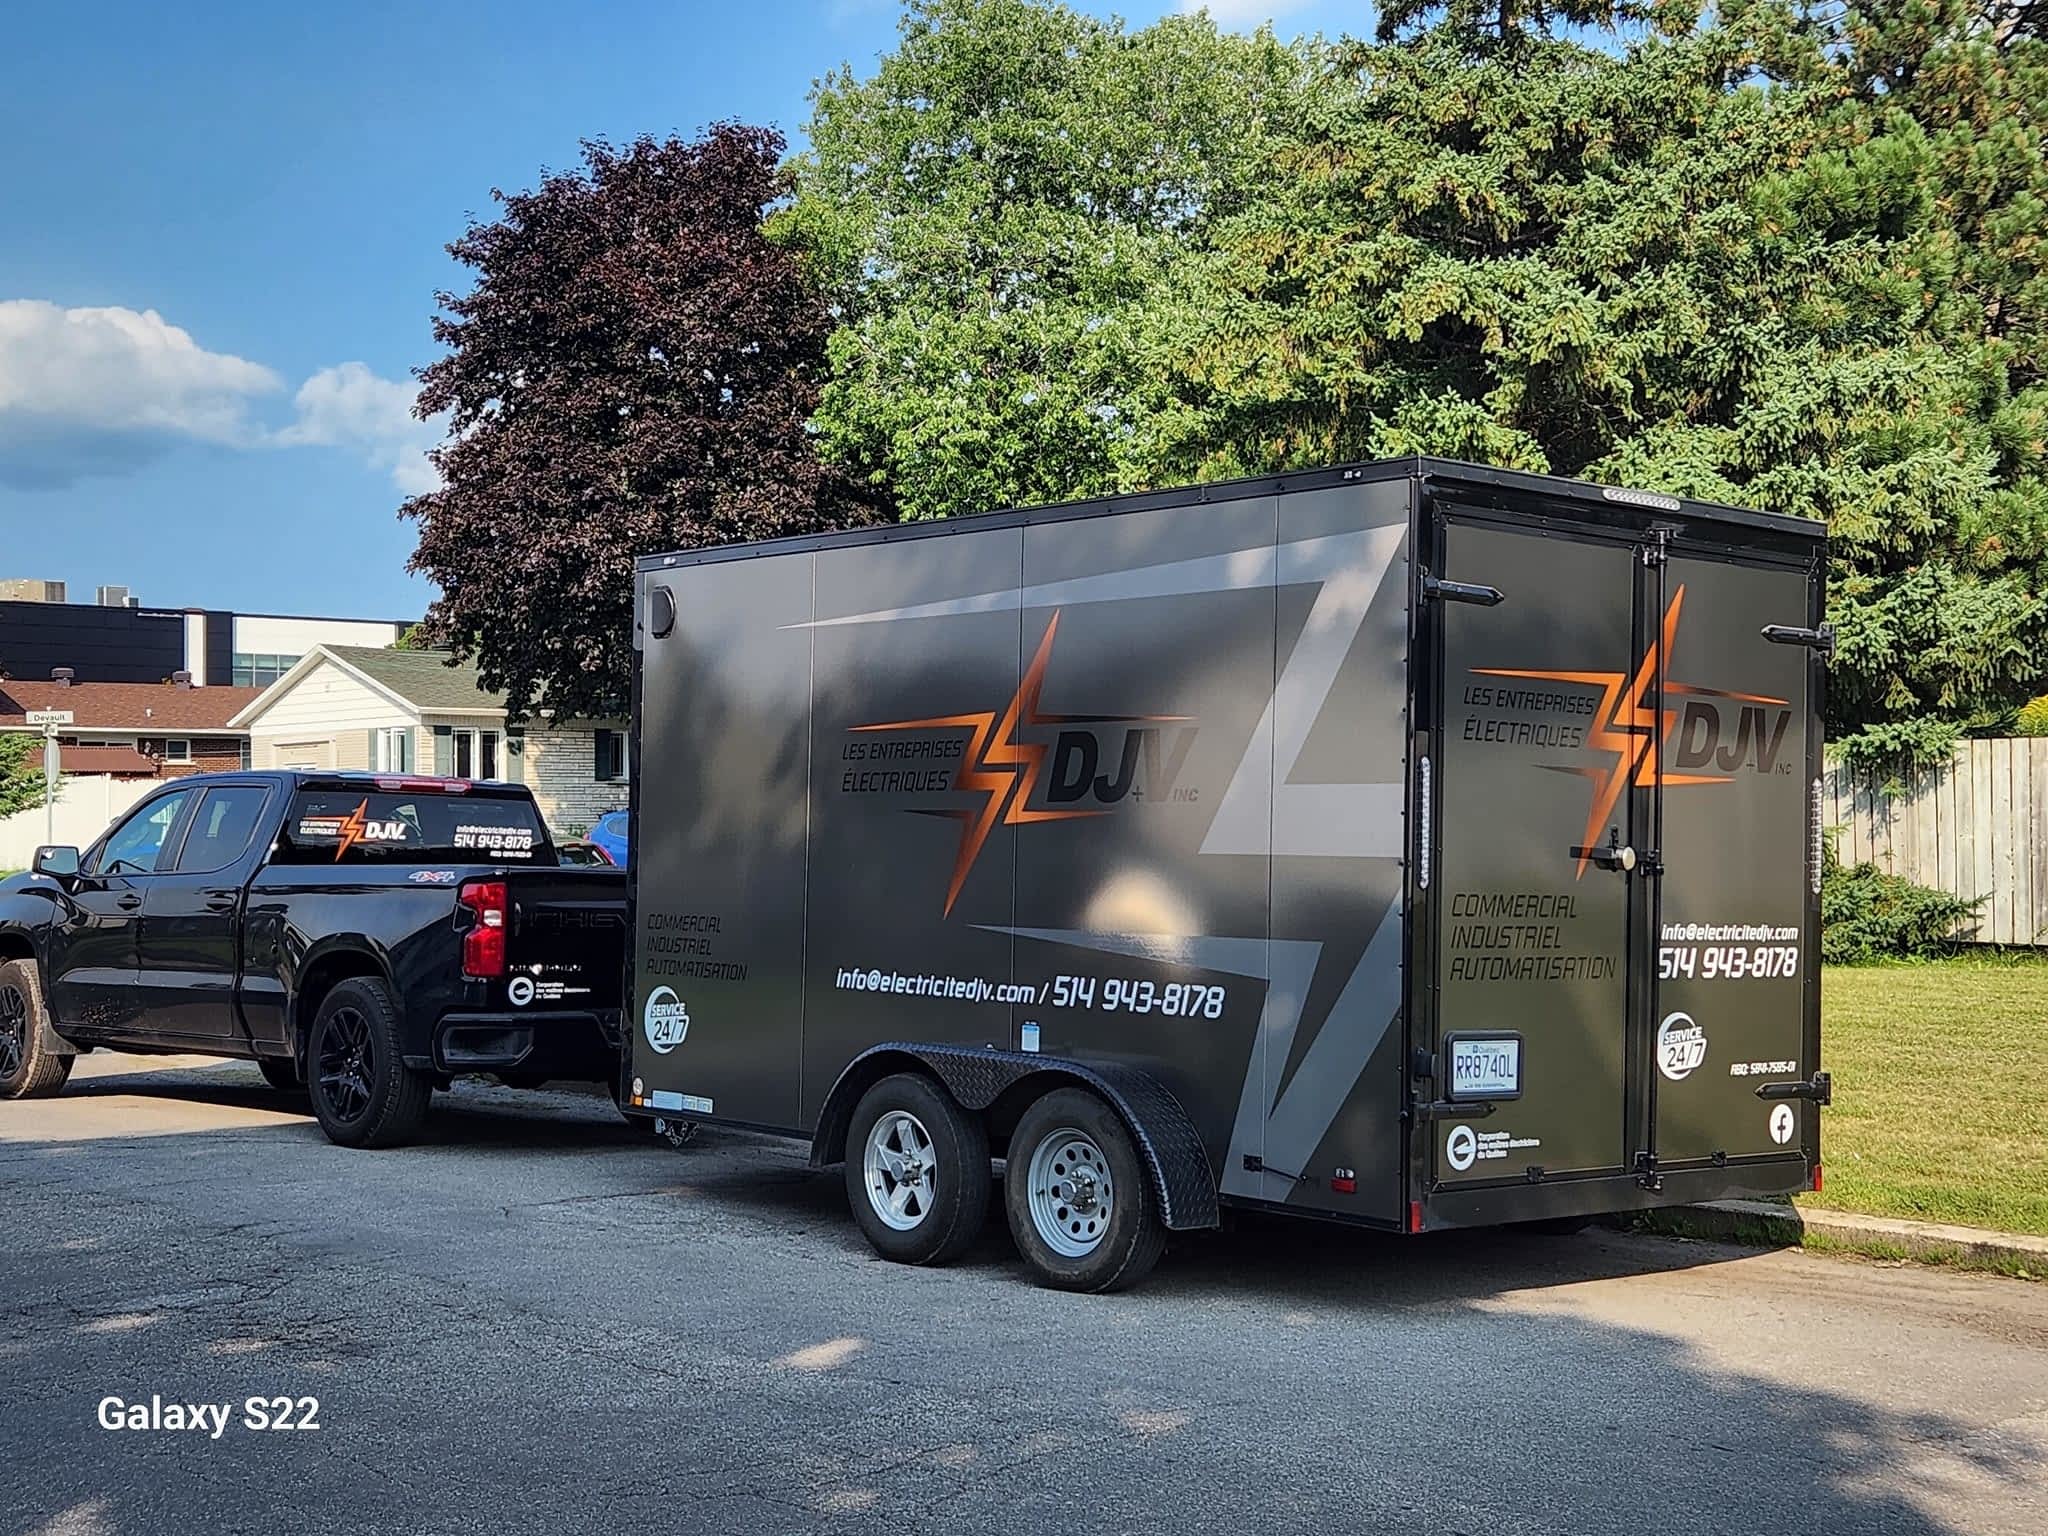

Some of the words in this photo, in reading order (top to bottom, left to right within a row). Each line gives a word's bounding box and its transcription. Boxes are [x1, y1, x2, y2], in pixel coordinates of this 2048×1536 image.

[1463, 686, 1492, 706] LES
[1495, 690, 1595, 716] ENTREPRISES
[1463, 714, 1584, 748] ÉLECTRIQUES
[842, 744, 866, 760] LES
[869, 740, 963, 760] ENTREPRISES
[842, 768, 951, 792] ÉLECTRIQUES
[1775, 763, 1792, 775] INC
[1173, 788, 1199, 801] INC
[454, 833, 476, 847] 514
[477, 834, 532, 849] 943-8178
[1451, 894, 1577, 918] COMMERCIAL
[648, 914, 721, 933] COMMERCIAL
[1661, 924, 1798, 942] info@electricitedjv.com
[648, 936, 712, 955] INDUSTRIEL
[1450, 925, 1561, 949] INDUSTRIEL
[646, 959, 748, 981] AUTOMATISATION
[1450, 957, 1616, 981] AUTOMATISATION
[1659, 948, 1696, 979] 514
[1702, 947, 1797, 979] 943-8178
[1053, 976, 1096, 1007] 514
[1102, 979, 1225, 1019] 943-8178
[651, 1003, 686, 1017] SERVICE
[653, 1019, 687, 1040] 24/7
[1665, 1027, 1703, 1044] SERVICE
[1456, 1054, 1514, 1079] RR8740L
[1667, 1043, 1705, 1068] 24/7
